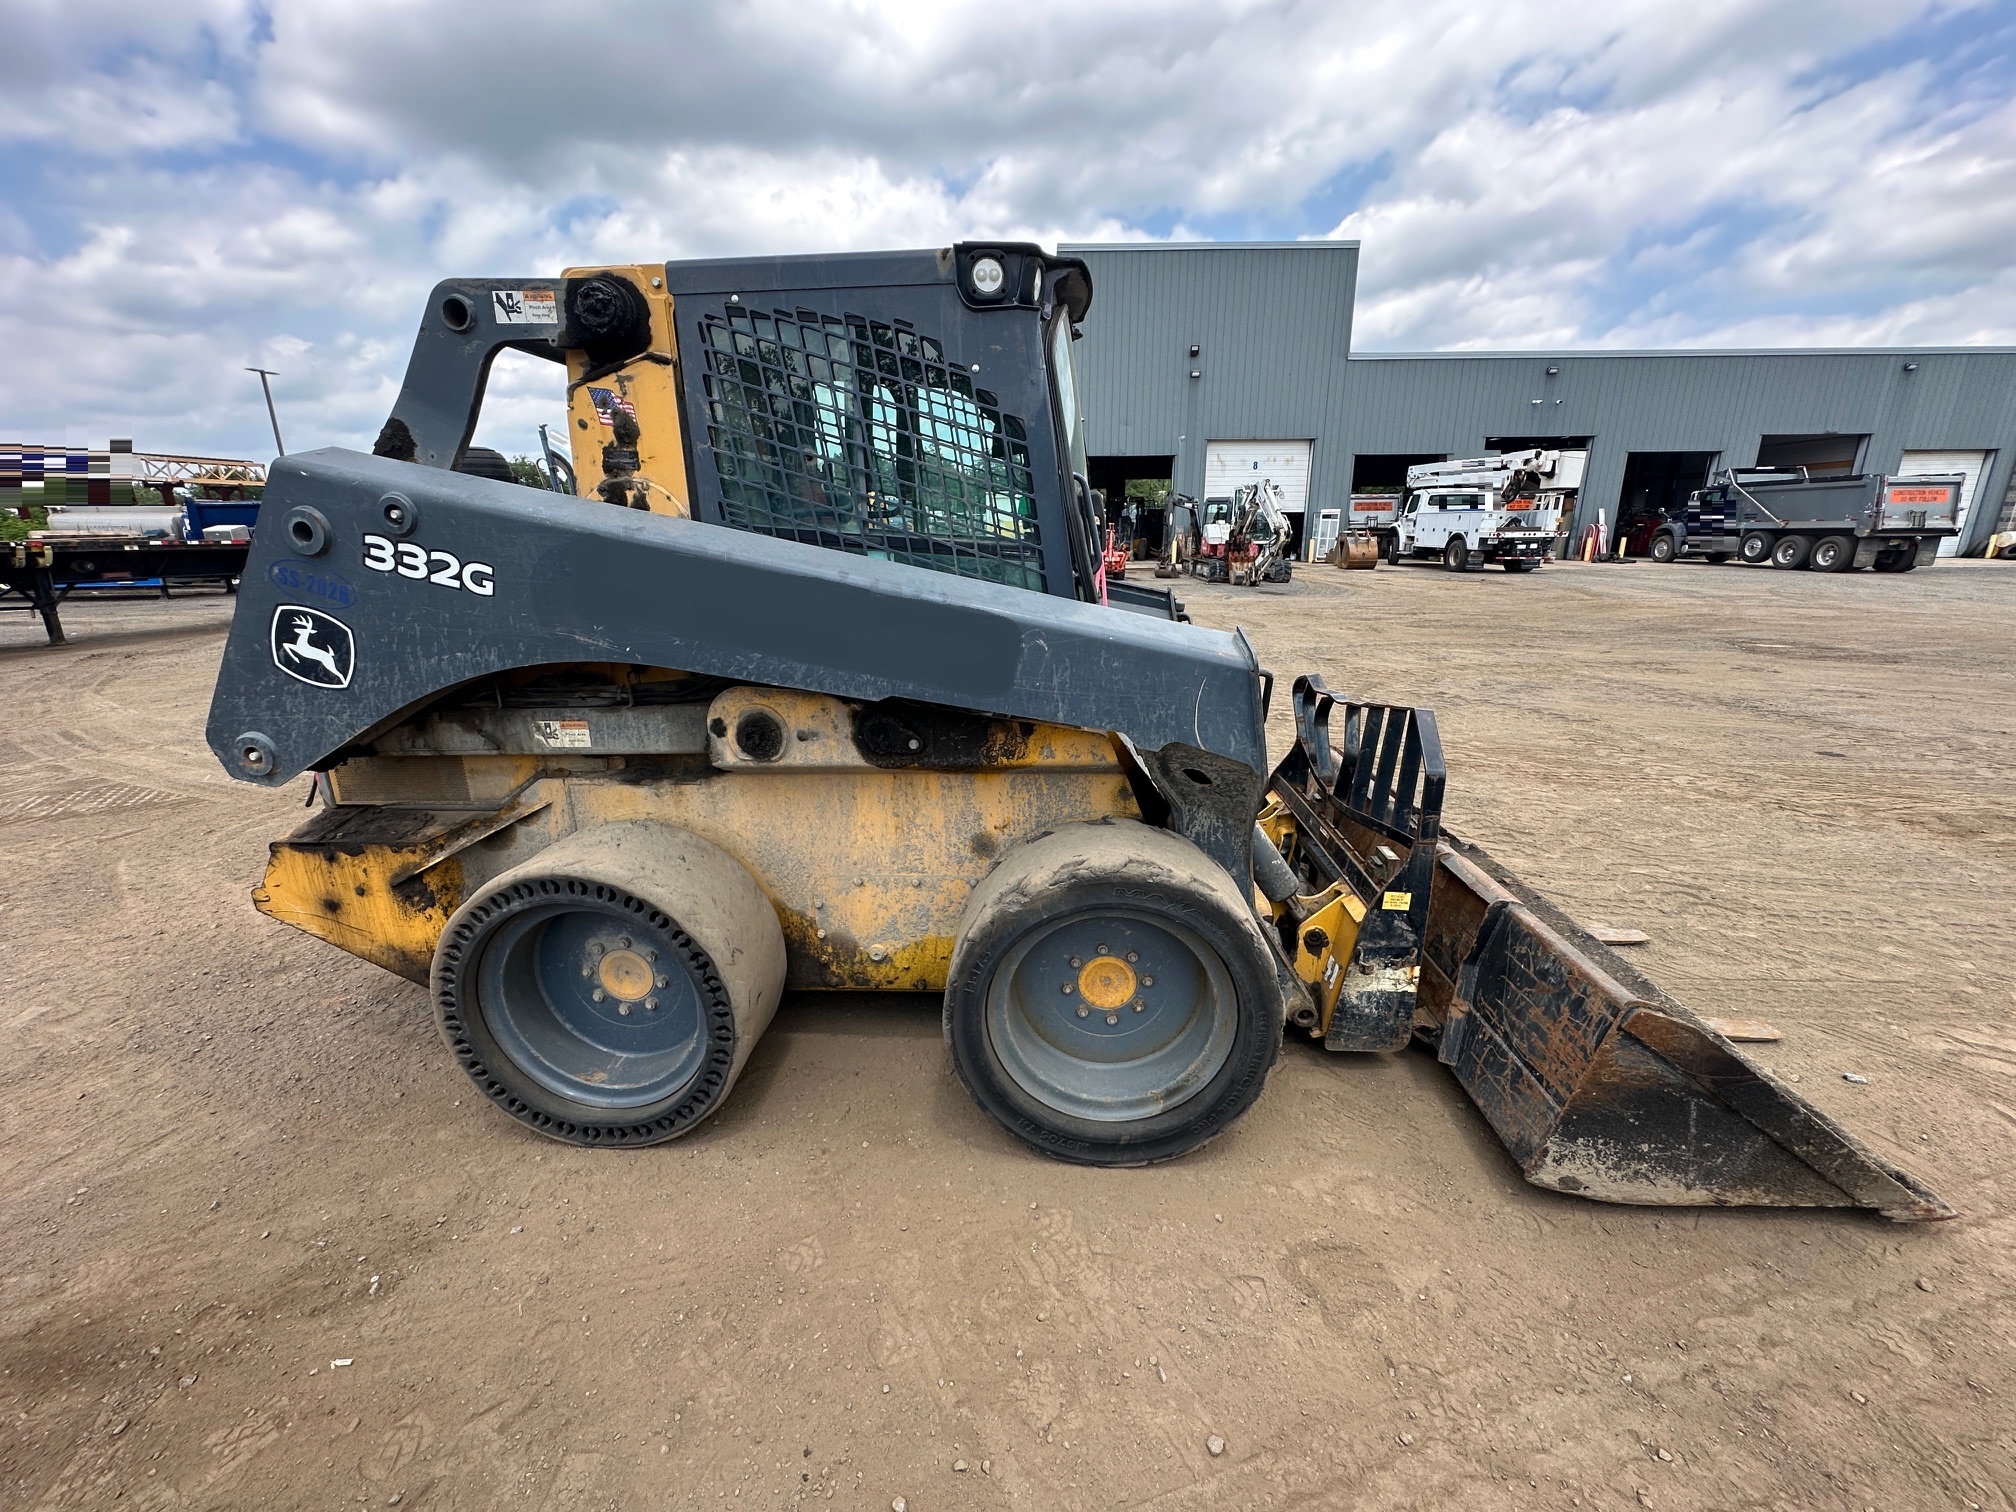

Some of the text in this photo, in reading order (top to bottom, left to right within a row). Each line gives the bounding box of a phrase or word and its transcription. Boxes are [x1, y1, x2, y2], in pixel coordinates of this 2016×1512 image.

[1253, 461, 1259, 470] 8
[363, 533, 494, 597] 332G
[1113, 887, 1231, 943] MAXAM
[1219, 1011, 1269, 1115] CONSTRUCTION
